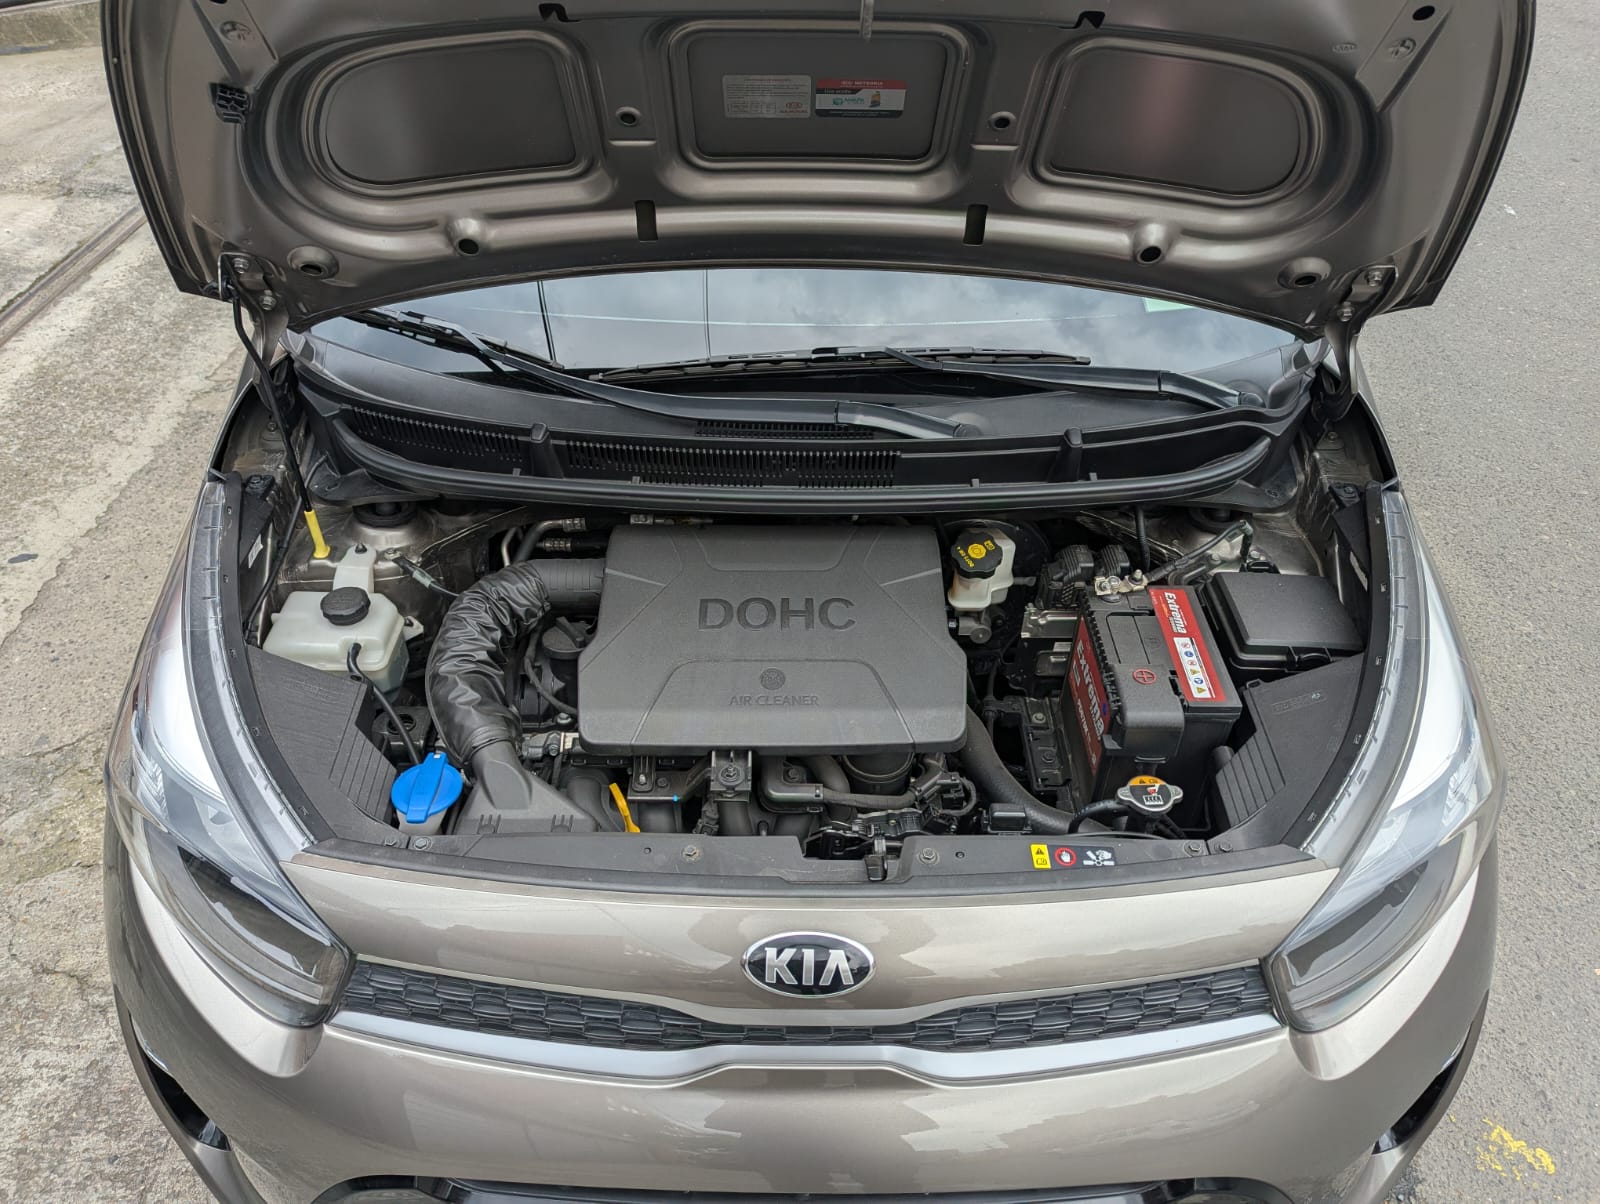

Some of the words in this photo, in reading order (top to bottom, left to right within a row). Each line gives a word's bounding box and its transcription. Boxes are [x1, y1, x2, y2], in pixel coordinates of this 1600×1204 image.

[699, 597, 856, 631] DOHC
[1164, 592, 1187, 634] Extrema
[729, 695, 753, 706] AIR
[757, 695, 820, 706] CLEANER
[1076, 639, 1105, 736] Extrema
[764, 947, 854, 986] KIA
